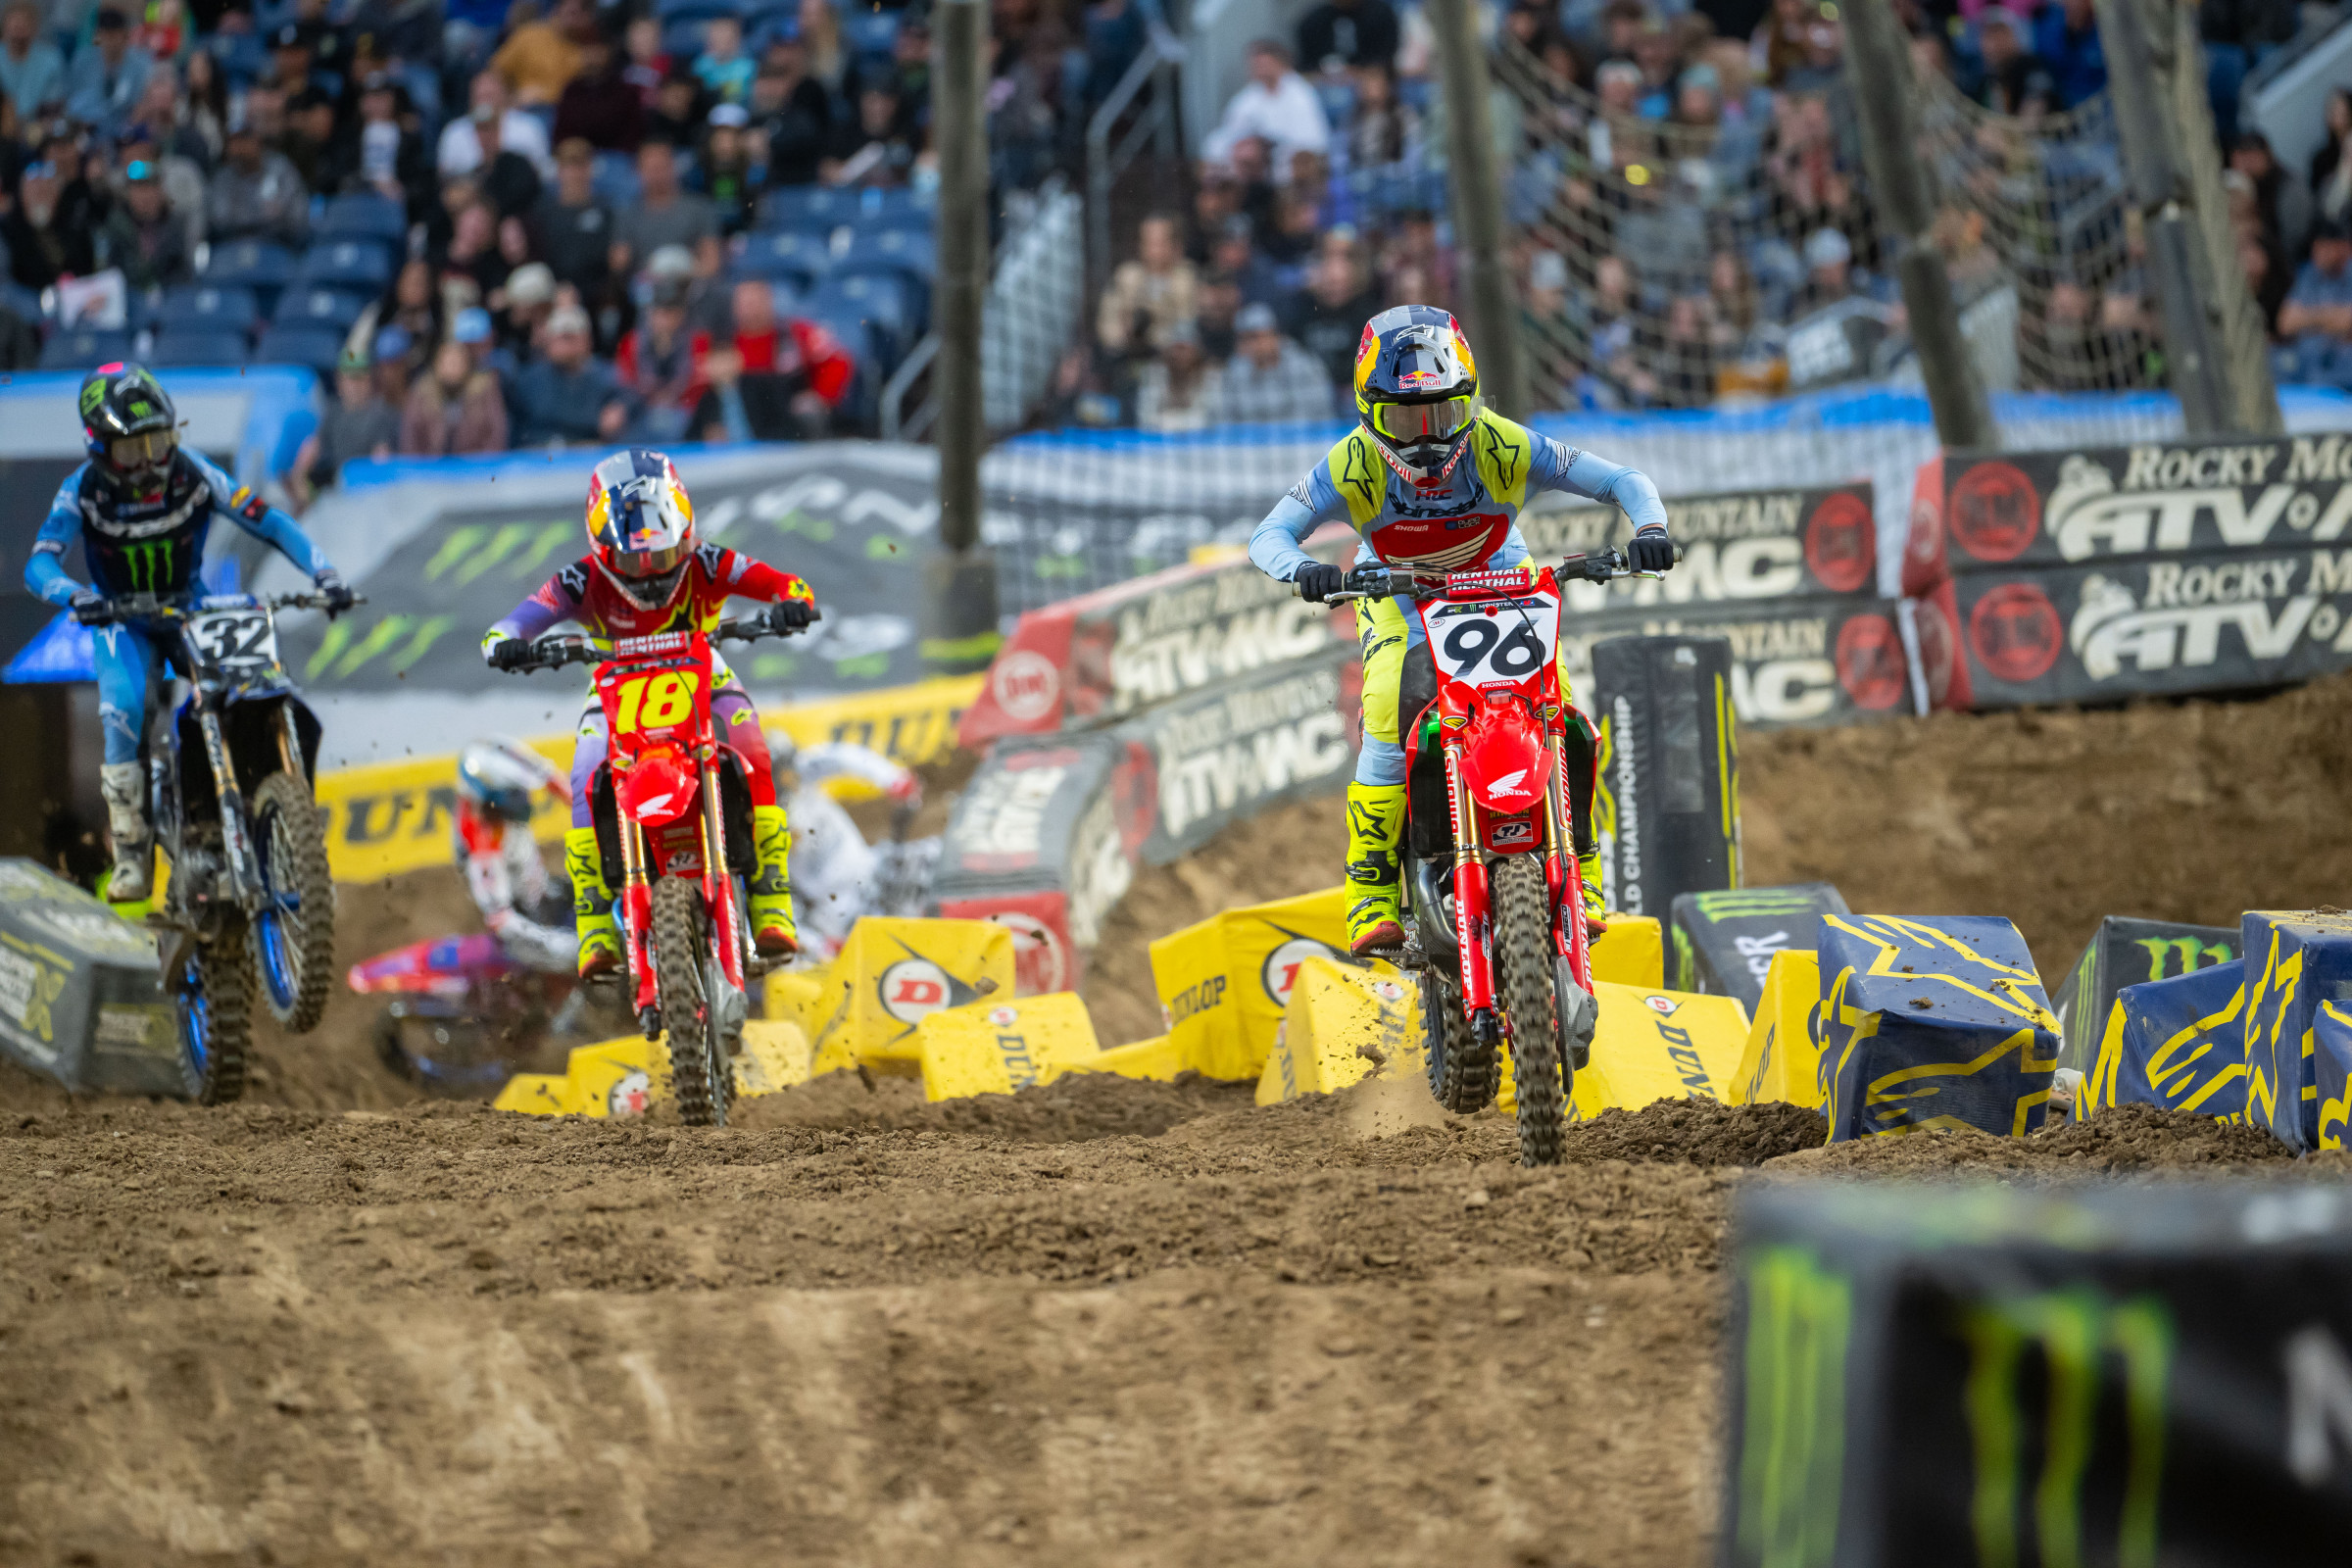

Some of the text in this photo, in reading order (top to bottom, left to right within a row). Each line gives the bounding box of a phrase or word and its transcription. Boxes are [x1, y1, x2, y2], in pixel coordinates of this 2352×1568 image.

[2123, 443, 2277, 489] ROCKY
[1457, 516, 1481, 525] QUAD
[2058, 484, 2295, 563] ATV
[1450, 568, 1525, 580] RENTHAL
[1451, 575, 1526, 592] RENTHAL
[2143, 560, 2296, 608] ROCKY
[202, 616, 270, 663] 32
[1444, 617, 1546, 683] 96
[2082, 597, 2321, 682] ATV
[615, 670, 700, 735] 18
[1481, 679, 1516, 688] HONDA
[1489, 789, 1533, 801] HONDA
[1614, 695, 1642, 881] CHAMPIONSHIP
[1501, 824, 1521, 837] TJ
[1456, 899, 1471, 991] DUNLOP
[1577, 890, 1592, 985] DUNLOP
[891, 980, 943, 1004] D
